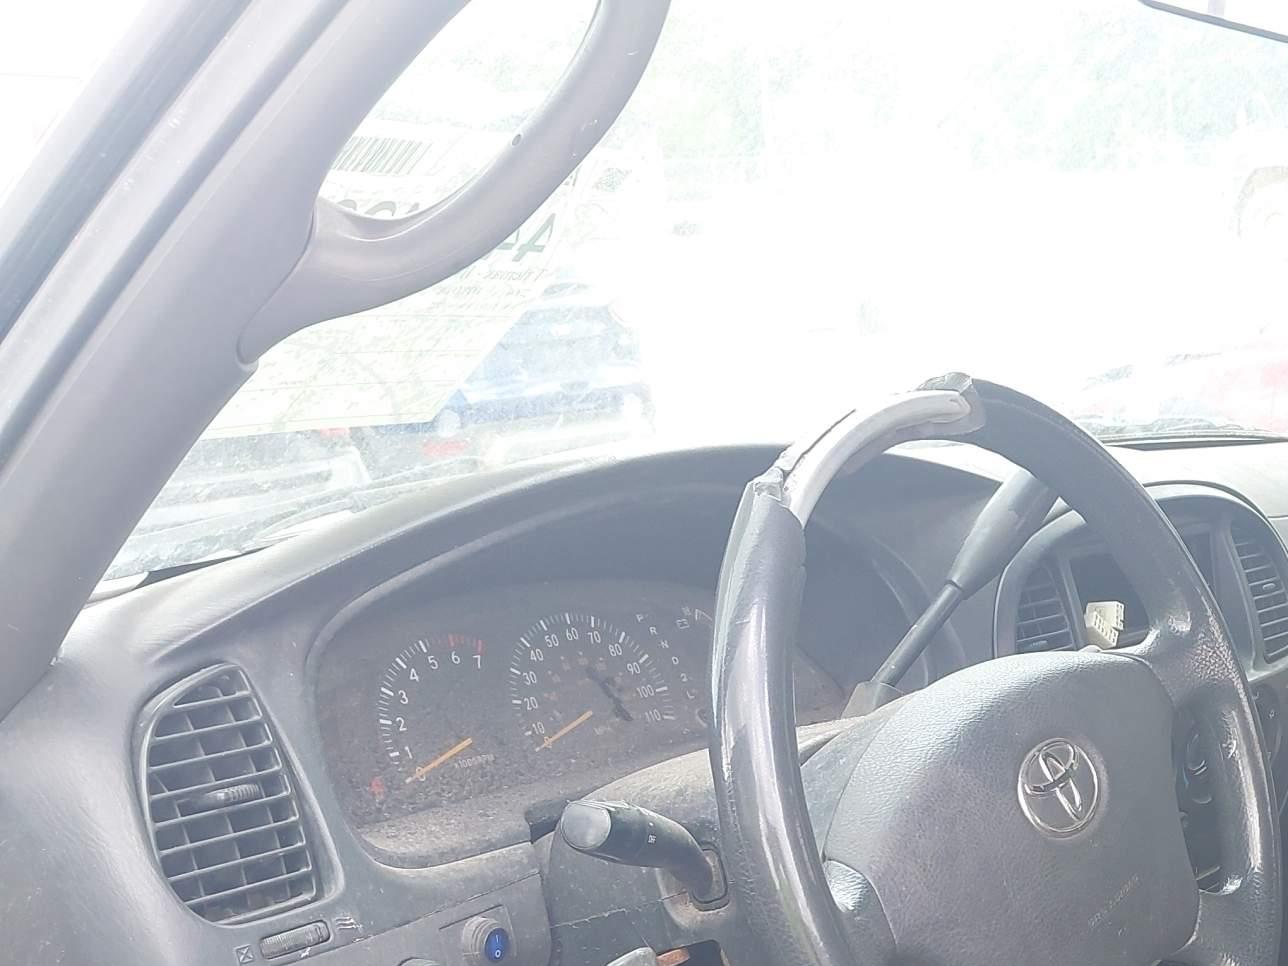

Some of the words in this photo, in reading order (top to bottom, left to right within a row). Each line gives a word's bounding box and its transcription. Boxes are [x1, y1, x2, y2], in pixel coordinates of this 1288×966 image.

[544, 634, 559, 648] 50
[565, 627, 579, 641] 60
[588, 630, 600, 644] 70
[530, 648, 543, 662] 40
[609, 643, 622, 657] 80
[428, 655, 439, 670] 5
[451, 651, 460, 664] 6
[473, 655, 481, 669] 7
[409, 668, 419, 682] 4
[627, 662, 641, 676] 90
[523, 671, 537, 685] 30
[399, 690, 409, 705] 3
[637, 684, 654, 699] 100
[523, 696, 538, 711] 20
[645, 709, 661, 723] 110
[396, 717, 407, 731] 2
[532, 721, 545, 735] 10
[404, 746, 413, 759] 1
